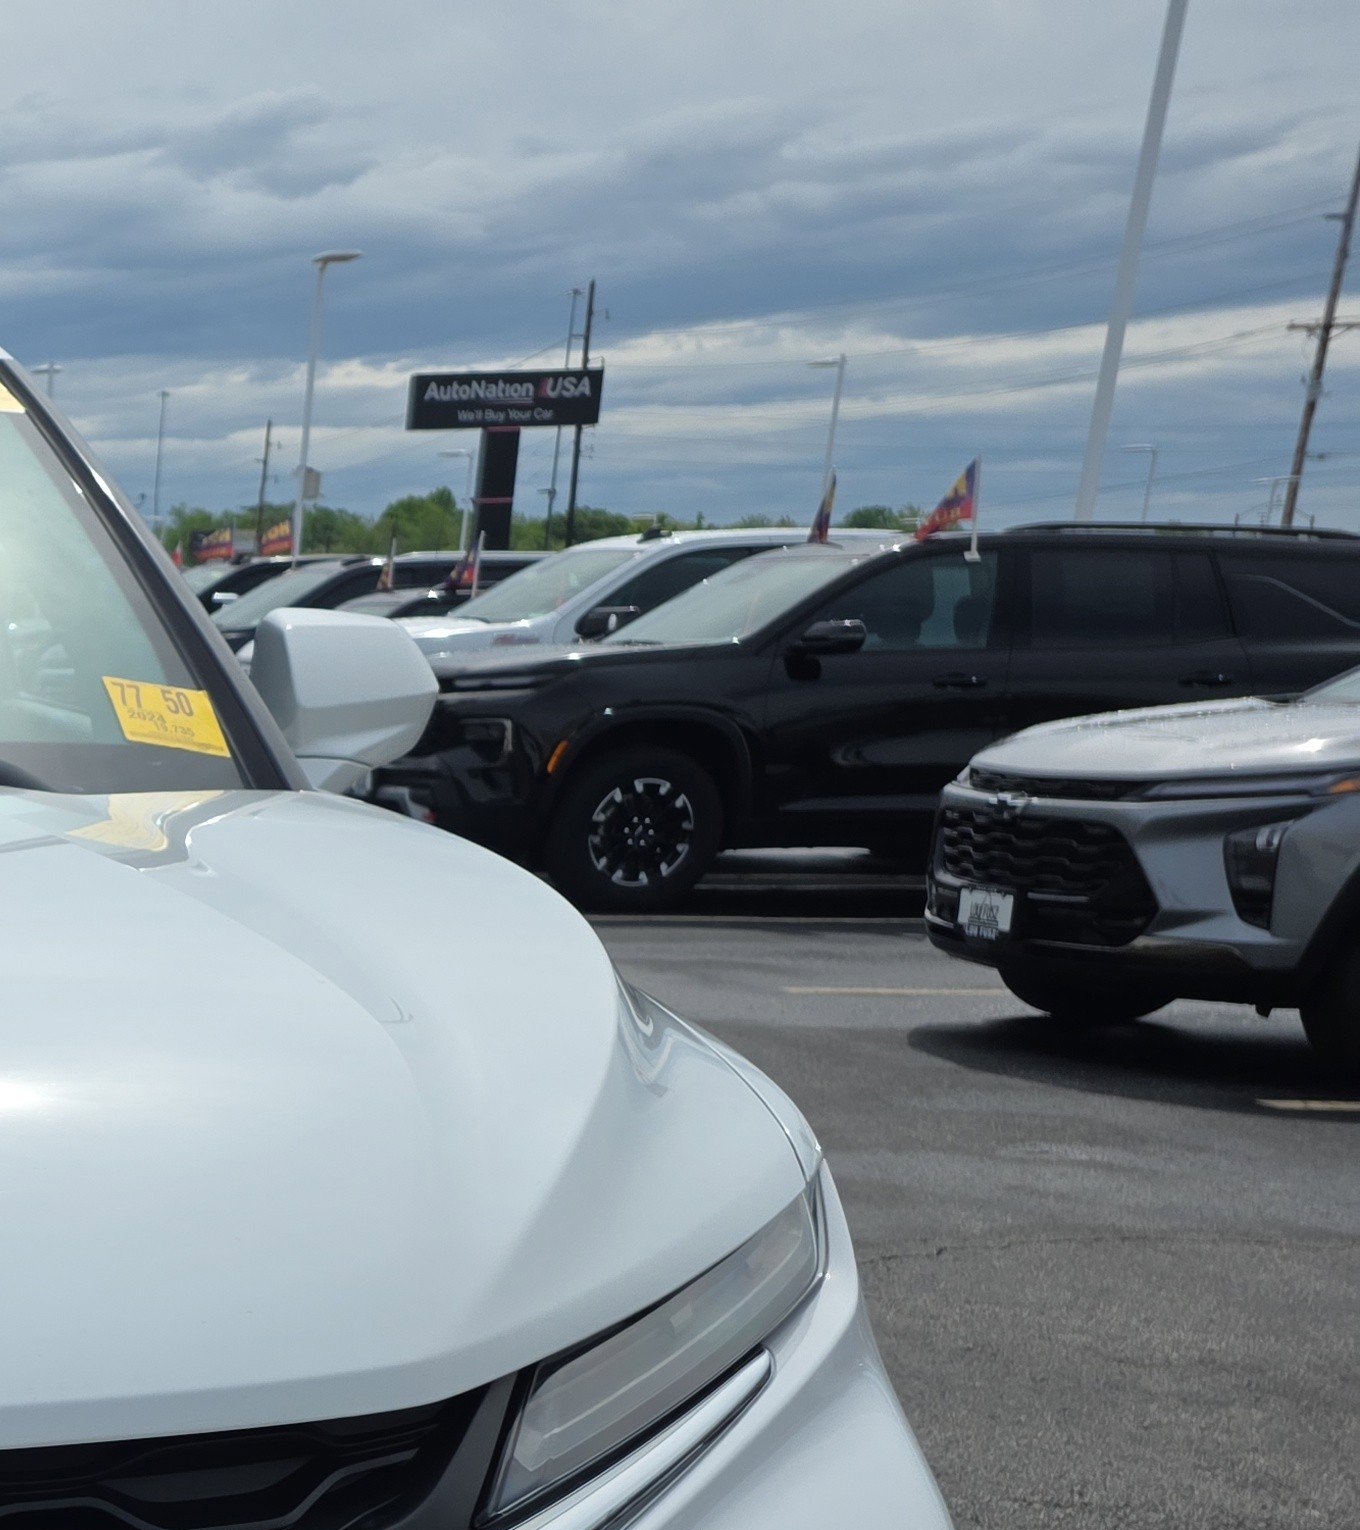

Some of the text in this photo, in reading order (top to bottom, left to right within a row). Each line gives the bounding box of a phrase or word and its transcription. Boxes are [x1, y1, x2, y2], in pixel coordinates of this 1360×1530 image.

[423, 375, 592, 401] AutoNation USA
[484, 408, 506, 422] Buy
[507, 407, 531, 421] Your
[533, 406, 555, 421] Car
[110, 681, 194, 717] 77 50
